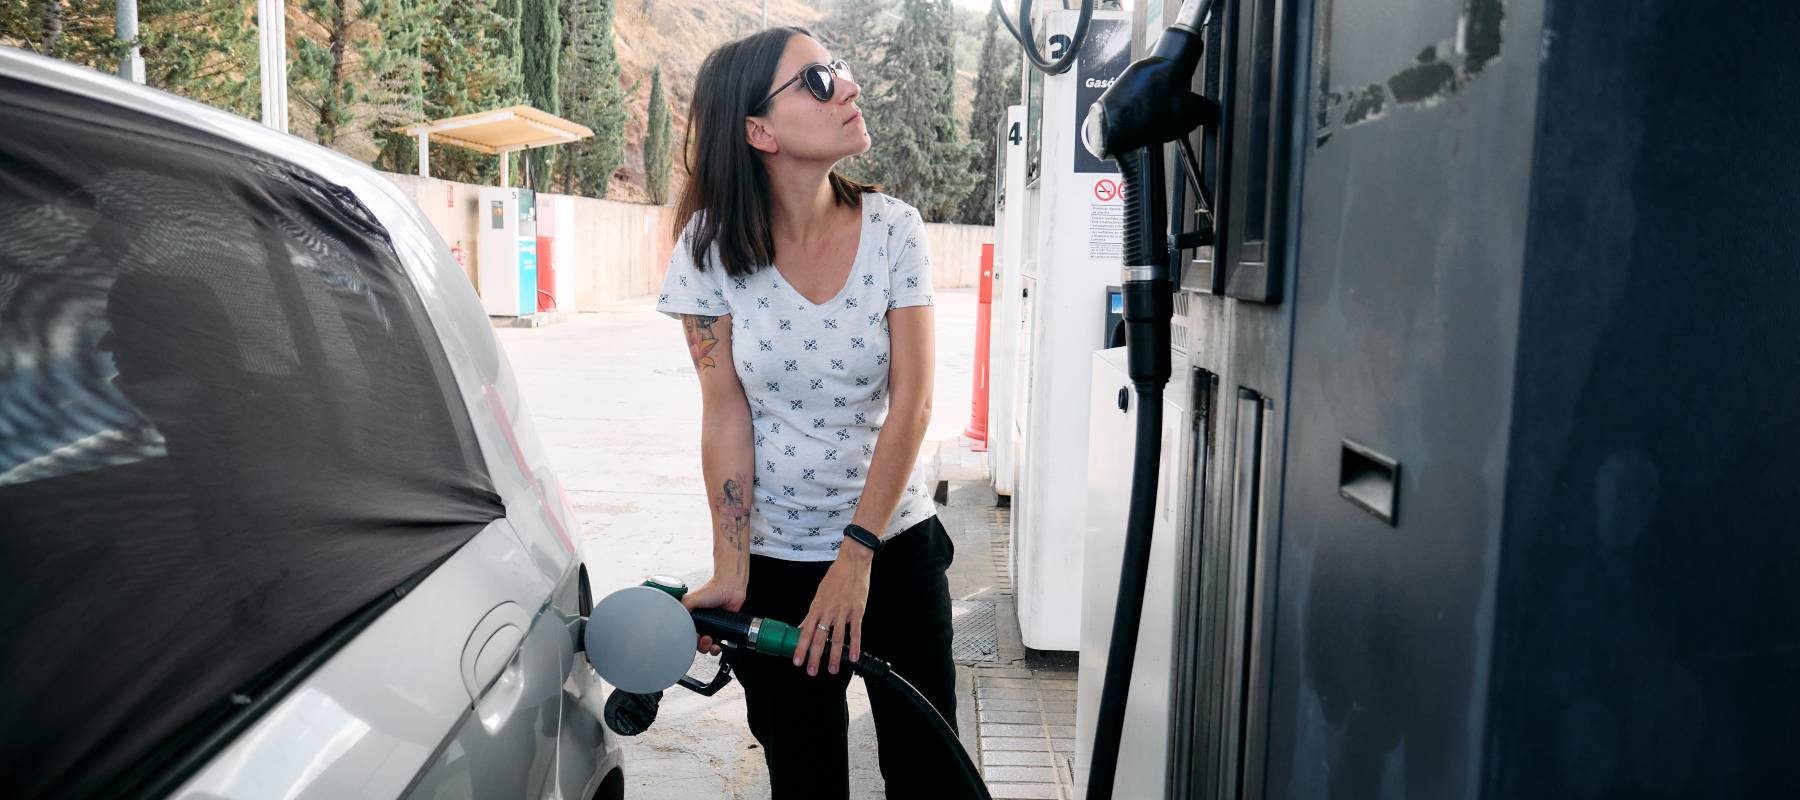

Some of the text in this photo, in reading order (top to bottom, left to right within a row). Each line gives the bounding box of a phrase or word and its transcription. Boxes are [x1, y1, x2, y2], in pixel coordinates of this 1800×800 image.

[1085, 77, 1118, 88] Gasó
[1008, 121, 1022, 146] 4
[511, 192, 517, 200] 5
